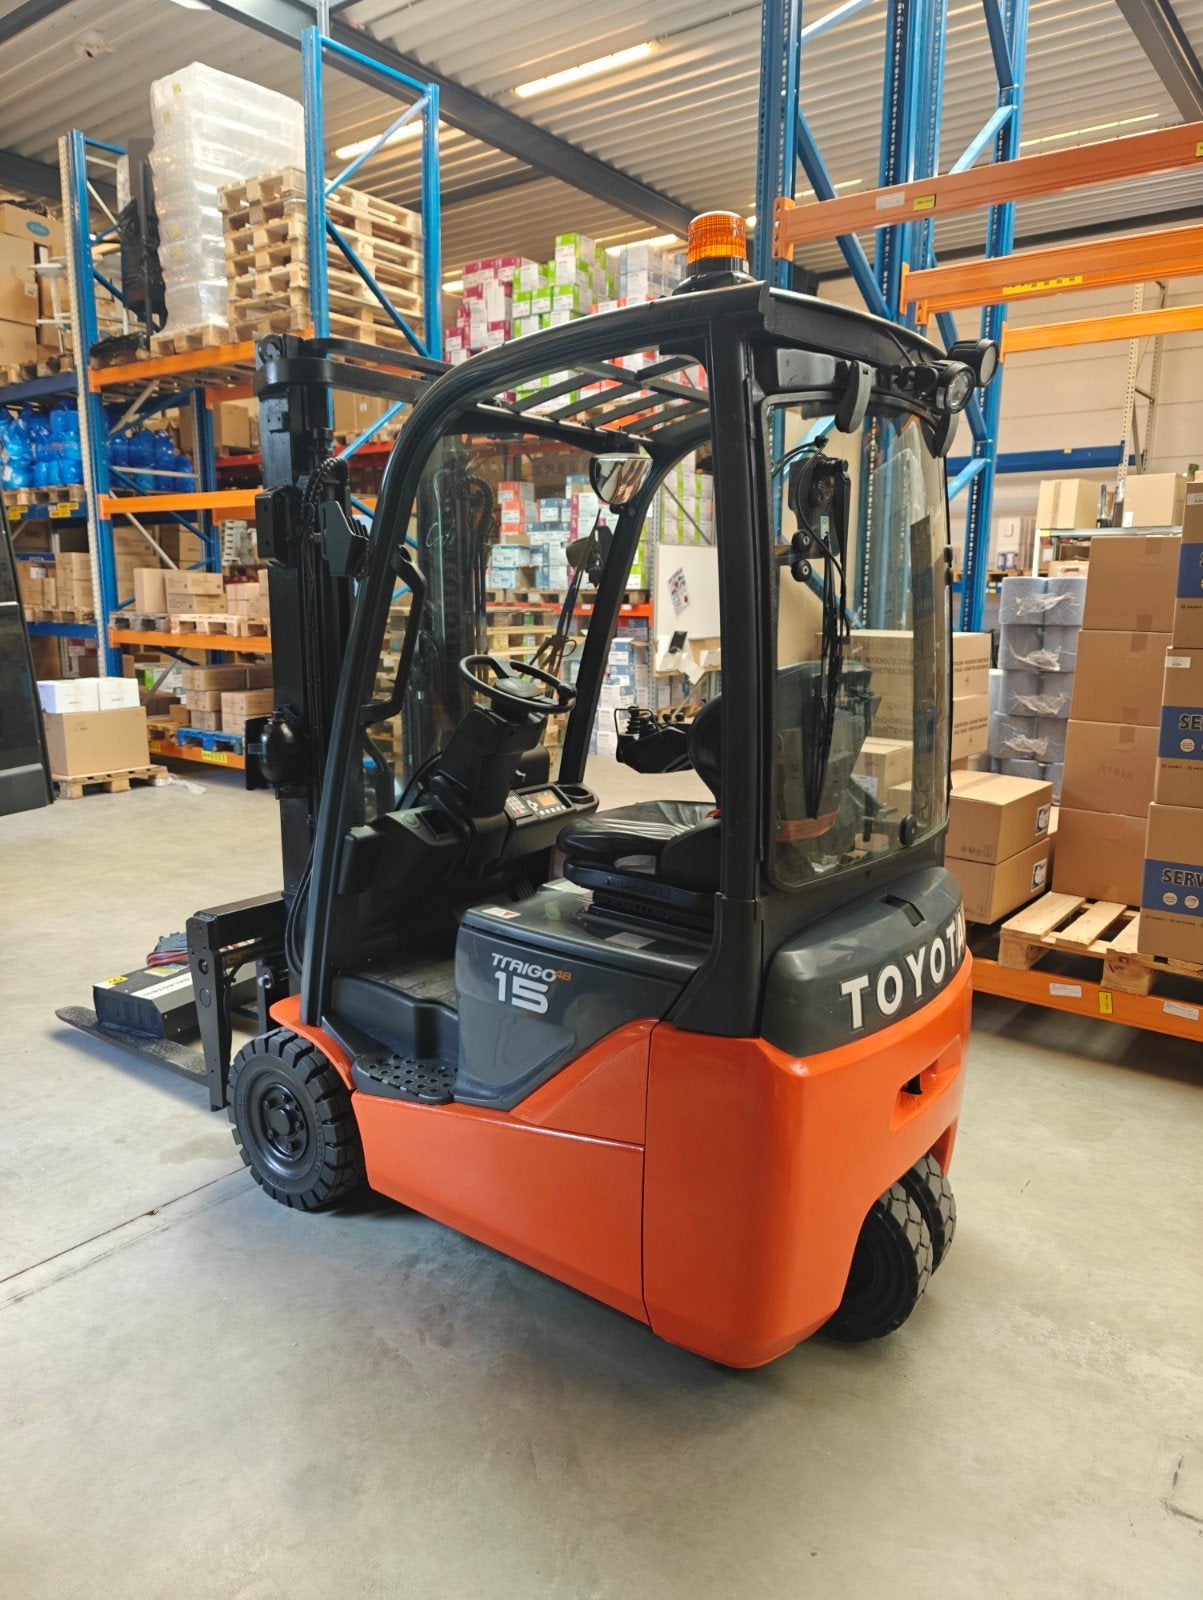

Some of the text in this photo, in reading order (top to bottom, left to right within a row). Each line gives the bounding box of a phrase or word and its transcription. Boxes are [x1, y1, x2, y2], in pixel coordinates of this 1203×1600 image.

[1179, 714, 1203, 731] SE
[1161, 868, 1203, 888] SERV
[492, 953, 557, 982] TRAIGO
[494, 970, 549, 1014] 15
